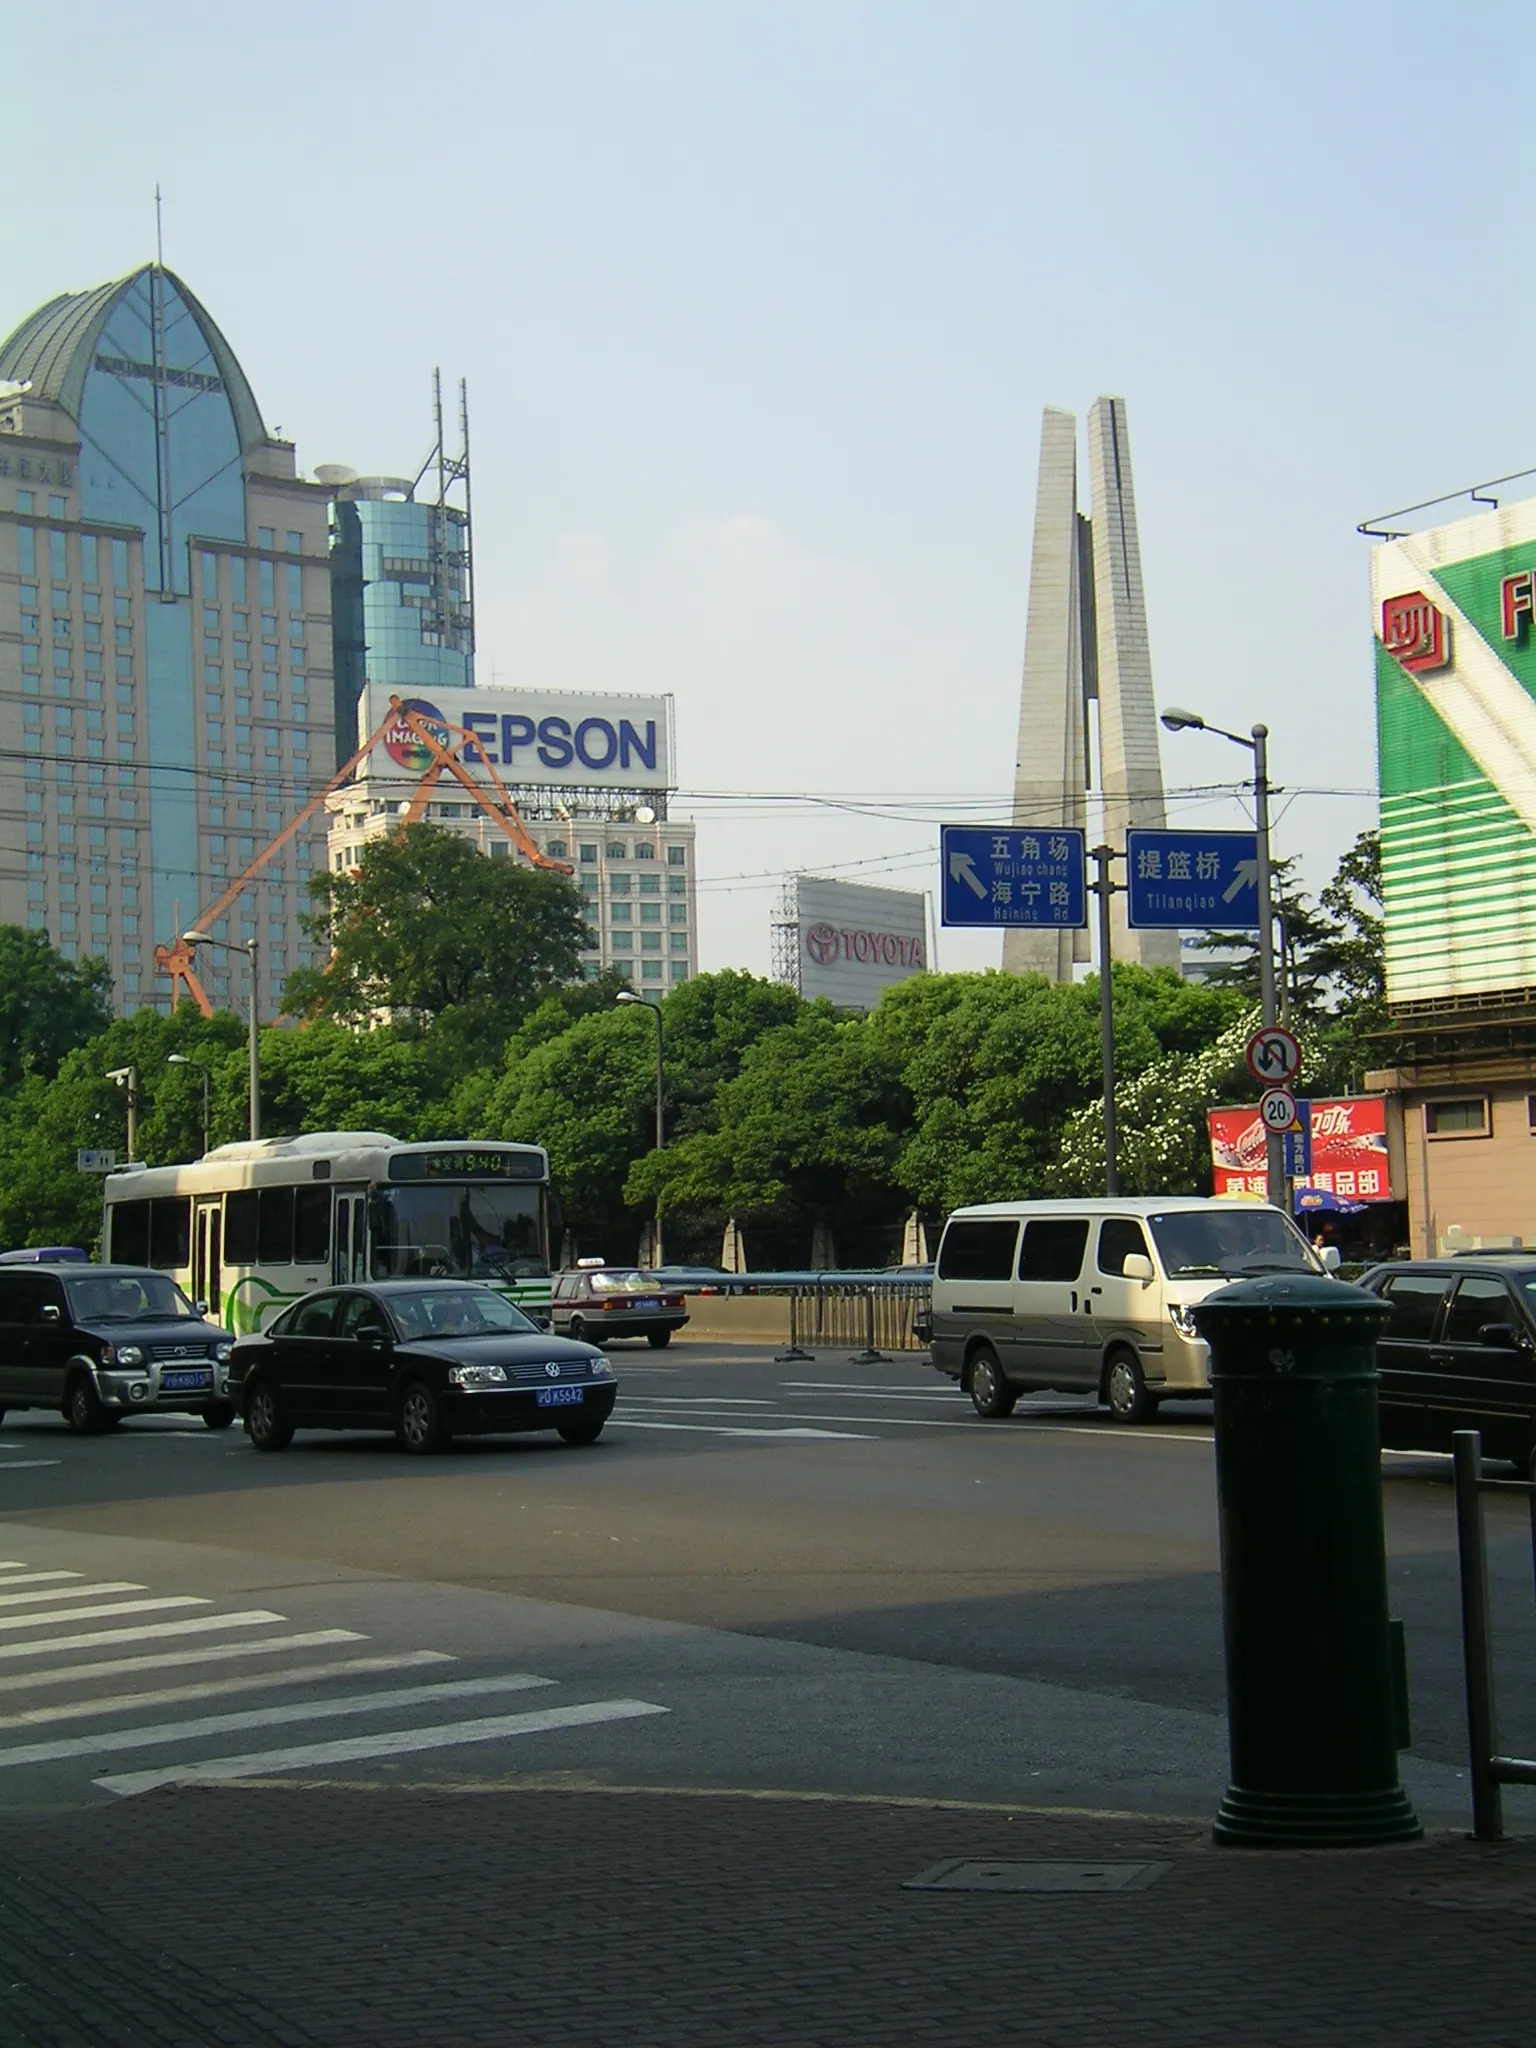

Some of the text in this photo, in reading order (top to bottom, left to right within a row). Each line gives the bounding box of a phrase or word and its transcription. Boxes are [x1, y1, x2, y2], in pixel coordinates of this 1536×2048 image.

[1501, 568, 1536, 640] F
[386, 729, 449, 746] IMAGG
[462, 711, 657, 770] EPSON
[990, 836, 1069, 861] 五角场
[995, 862, 1033, 878] Wujiao
[1137, 849, 1220, 880] 提篮桥
[991, 880, 1070, 906] 海宁路
[1146, 893, 1215, 912] Tilanqiao
[1054, 907, 1068, 921] Rd
[841, 929, 925, 968] TOYOTA
[466, 1154, 501, 1172] 940
